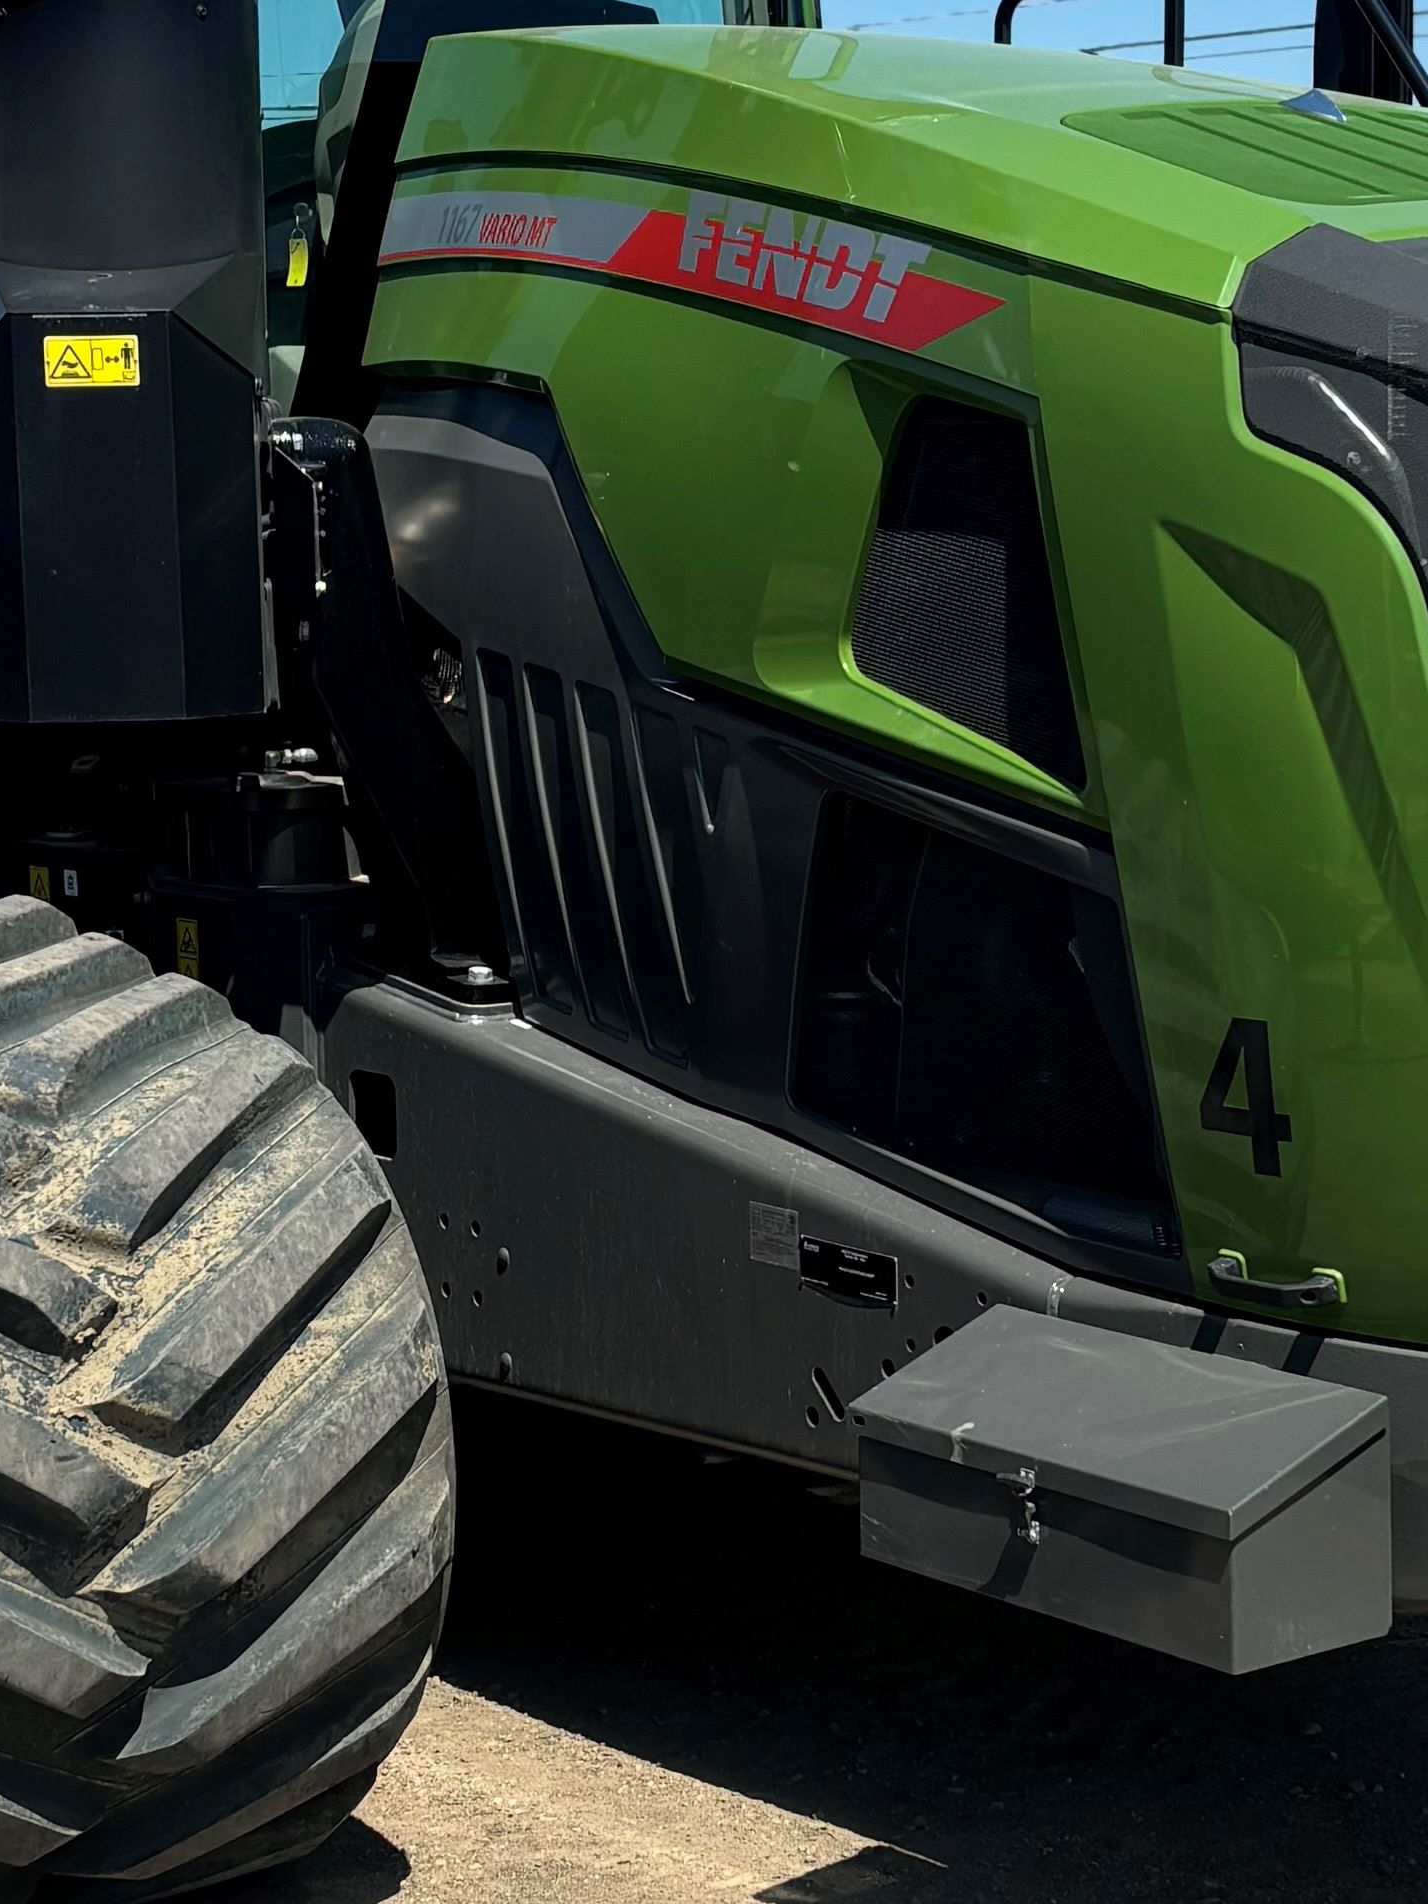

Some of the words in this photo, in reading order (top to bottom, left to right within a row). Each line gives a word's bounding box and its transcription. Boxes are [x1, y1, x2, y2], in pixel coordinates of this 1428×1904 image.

[438, 203, 483, 244] 1167
[478, 212, 527, 246] VARIO
[525, 215, 558, 249] MT
[678, 189, 932, 323] FENDT
[1200, 1016, 1292, 1178] 4
